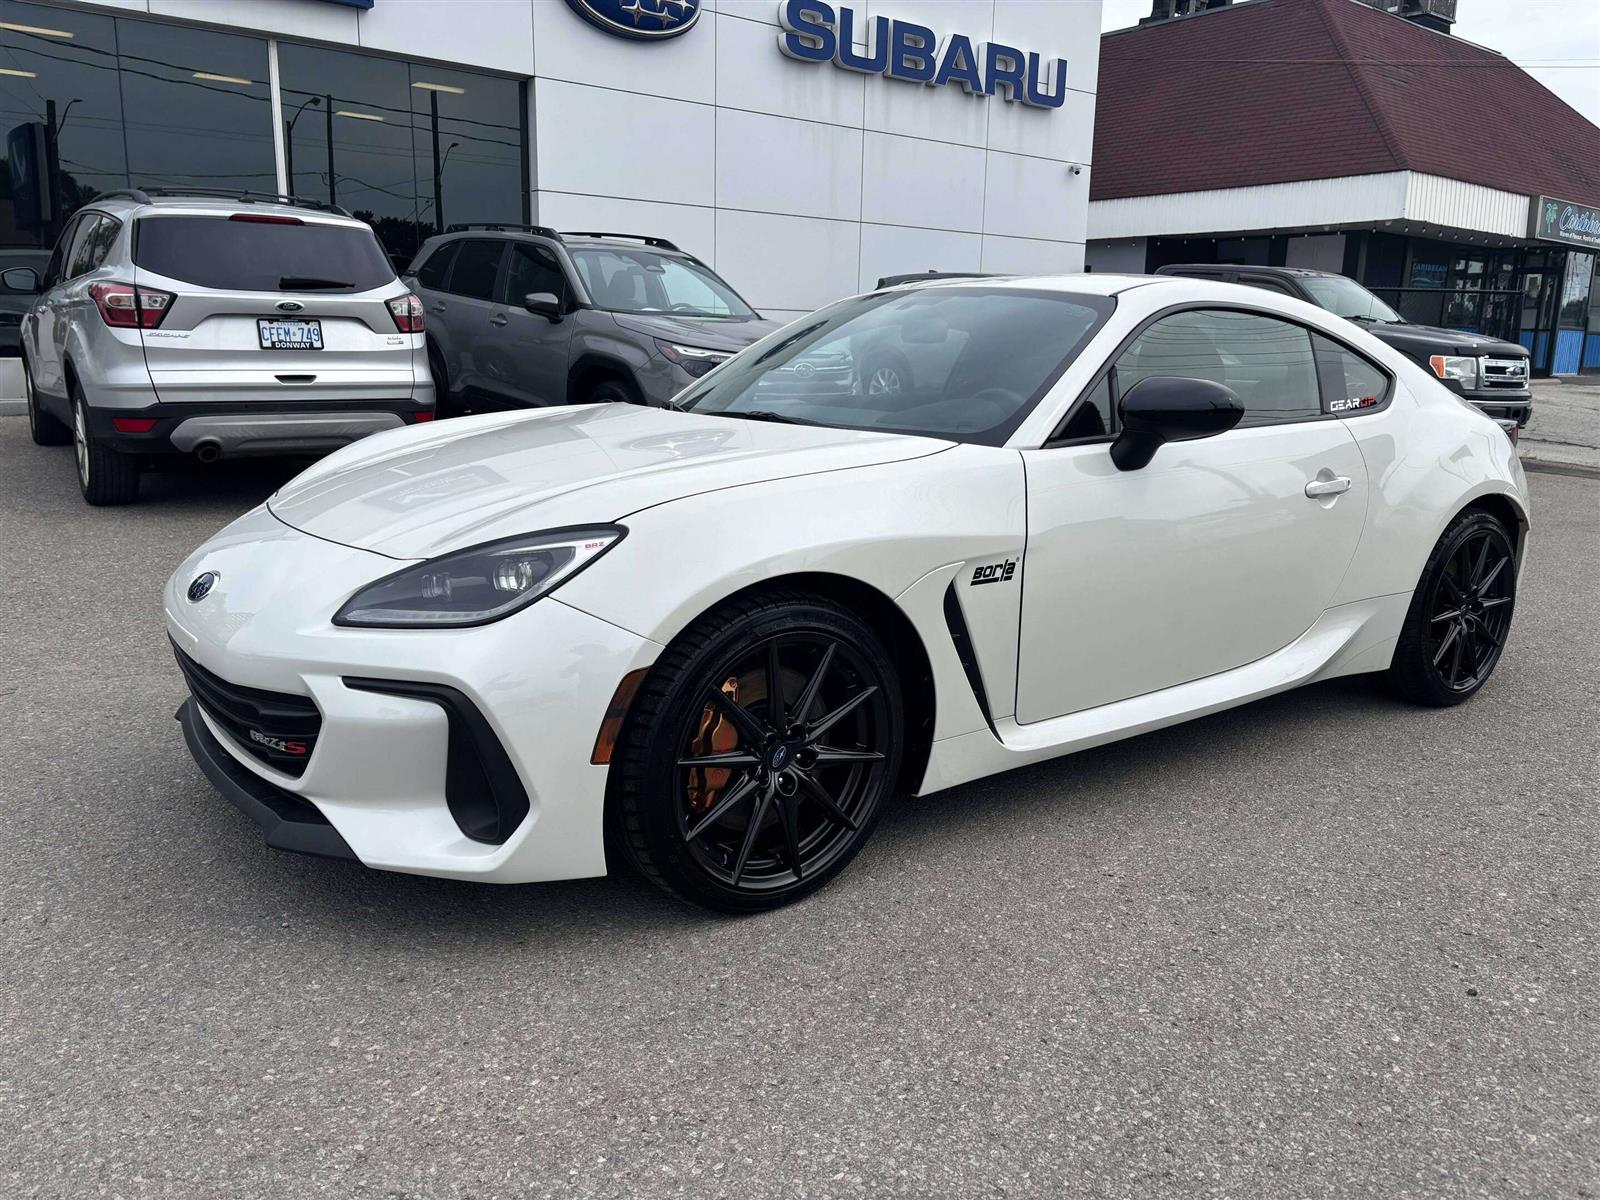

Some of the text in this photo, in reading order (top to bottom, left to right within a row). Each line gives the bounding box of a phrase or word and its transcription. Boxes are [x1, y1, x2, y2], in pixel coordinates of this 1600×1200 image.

[779, 0, 1067, 108] SUBARU
[298, 327, 320, 342] 749
[584, 541, 604, 549] BRZ
